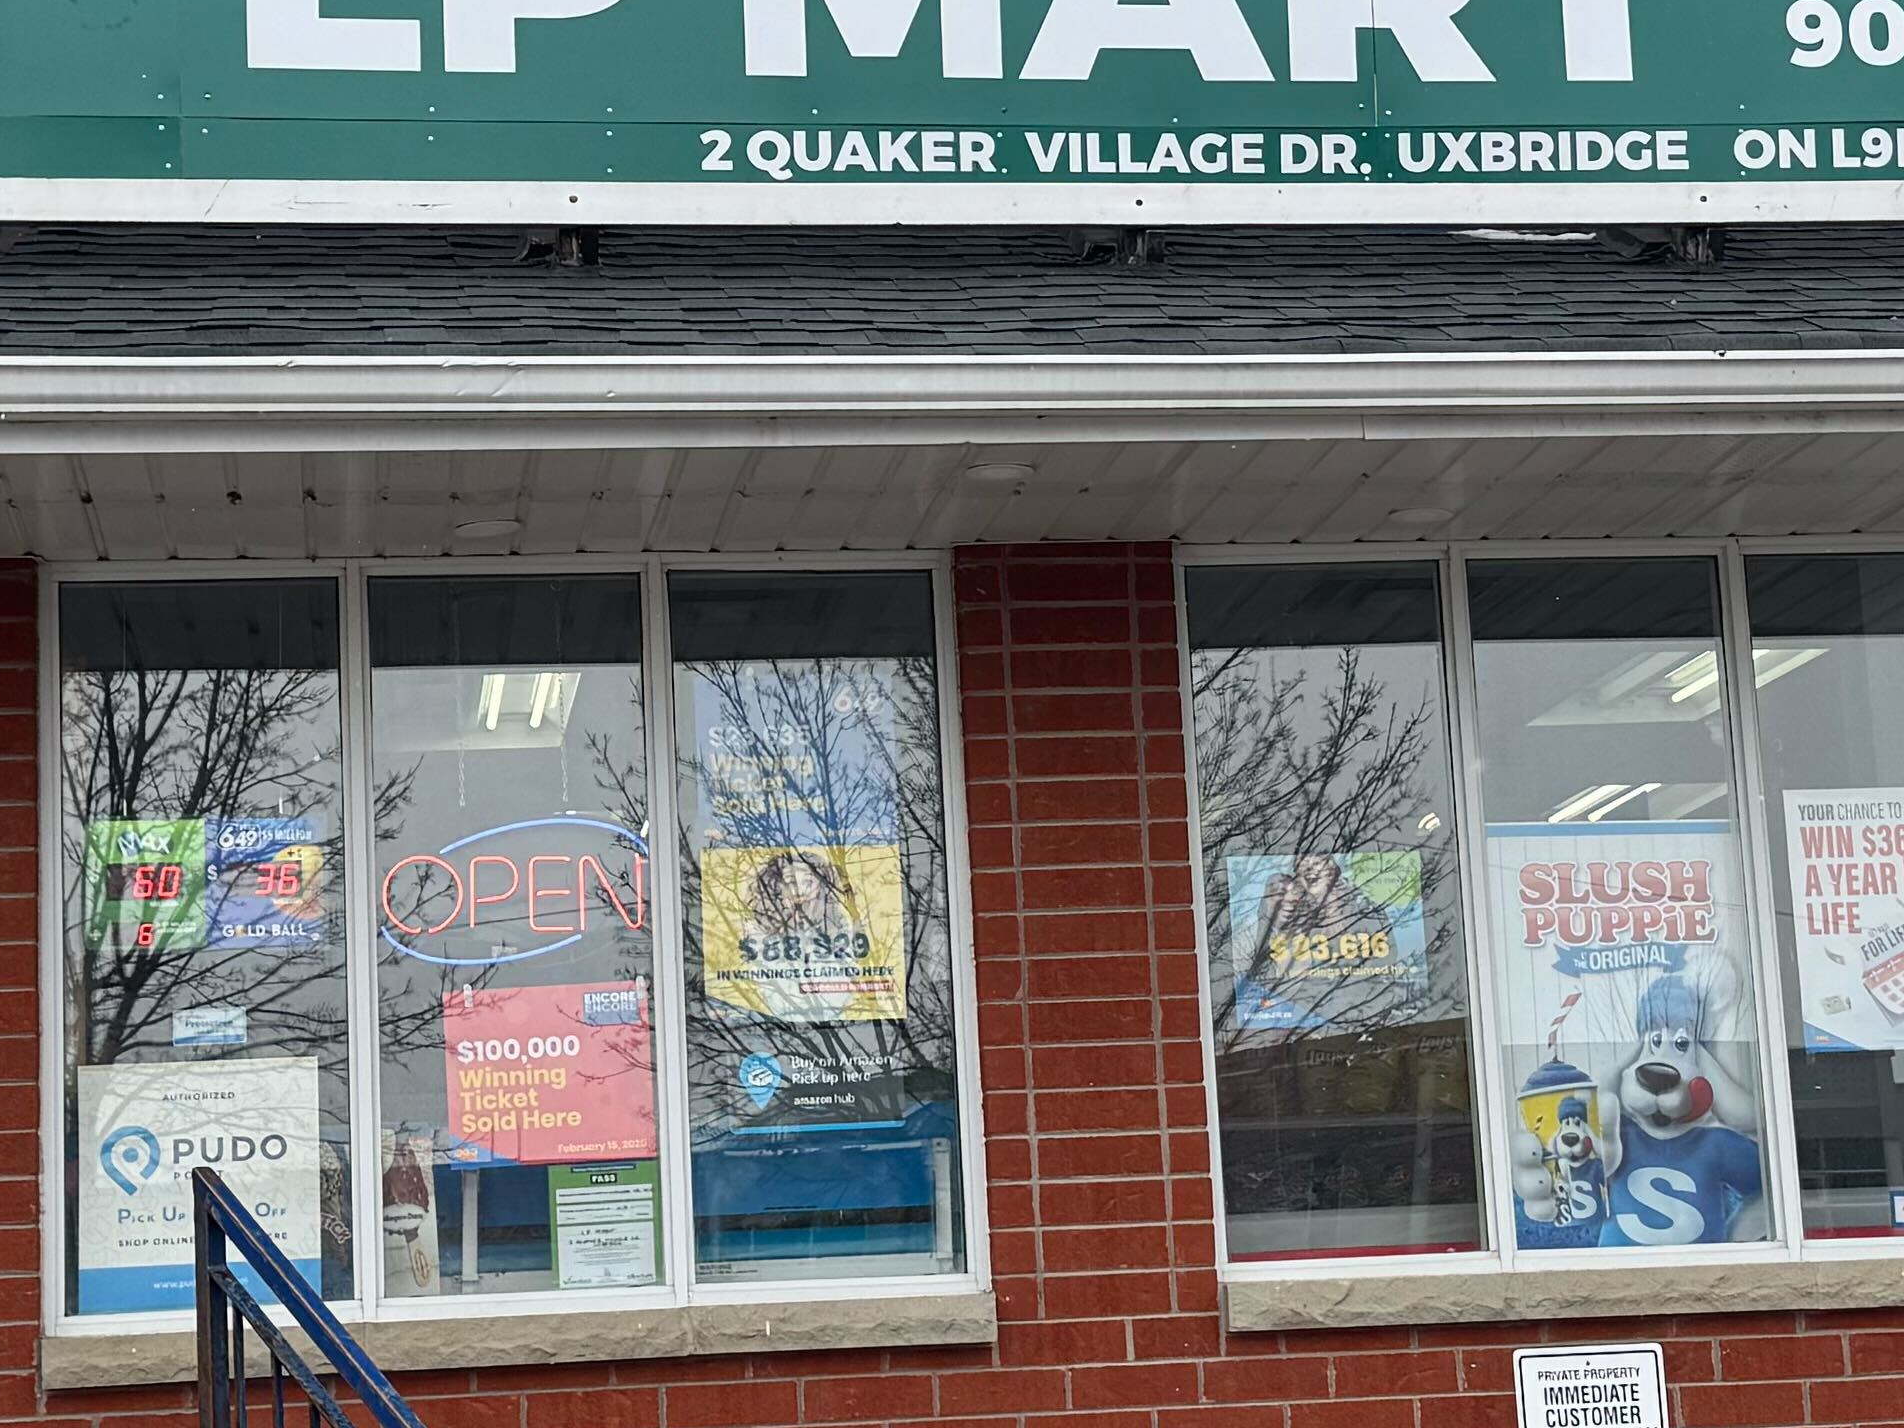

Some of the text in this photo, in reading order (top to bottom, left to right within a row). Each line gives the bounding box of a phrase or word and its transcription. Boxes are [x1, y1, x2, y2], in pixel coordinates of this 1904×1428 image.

[699, 129, 734, 171] 2
[745, 128, 994, 182] QUAKER
[1023, 131, 1265, 174] VILLAGE
[1280, 133, 1372, 175] DR.
[1397, 129, 1689, 173] UXBRIDGE
[1732, 128, 1817, 170] ON
[1797, 801, 1902, 821] YOUR CHANCE TO
[1799, 825, 1854, 859] WIN
[133, 865, 182, 899] 60
[255, 863, 301, 897] 36
[1519, 860, 1712, 905] SLUSH
[1804, 864, 1823, 897] A
[1826, 862, 1897, 897] YEAR
[381, 853, 645, 935] OPEN
[271, 923, 308, 936] BALL
[1806, 902, 1862, 935] LIFE
[138, 923, 154, 946] 6
[1589, 945, 1672, 971] ORIGINAL
[1860, 935, 1888, 962] FOR
[716, 970, 731, 982] IN
[733, 968, 801, 981] WINNINGS
[584, 992, 637, 1003] ENCORE
[456, 1034, 581, 1064] $100,000
[791, 1055, 893, 1071] Buy on Amazon
[459, 1064, 567, 1090] Winning
[821, 1072, 872, 1086] up here
[162, 1090, 236, 1102] AUTHORIZED
[460, 1087, 539, 1111] Ticket
[793, 1092, 856, 1106] amazon hub
[462, 1109, 582, 1134] Sold Here
[172, 1133, 288, 1165] PUDO
[557, 1141, 606, 1155] February
[591, 1174, 616, 1183] PASS
[1570, 1180, 1598, 1220] S
[1616, 1165, 1706, 1246] S
[118, 1238, 149, 1248] SHOP
[1537, 1367, 1641, 1382] PRIVATE PROPERTY
[1543, 1383, 1640, 1406] IMMEDIATE
[1545, 1405, 1642, 1428] CUSTOMER
